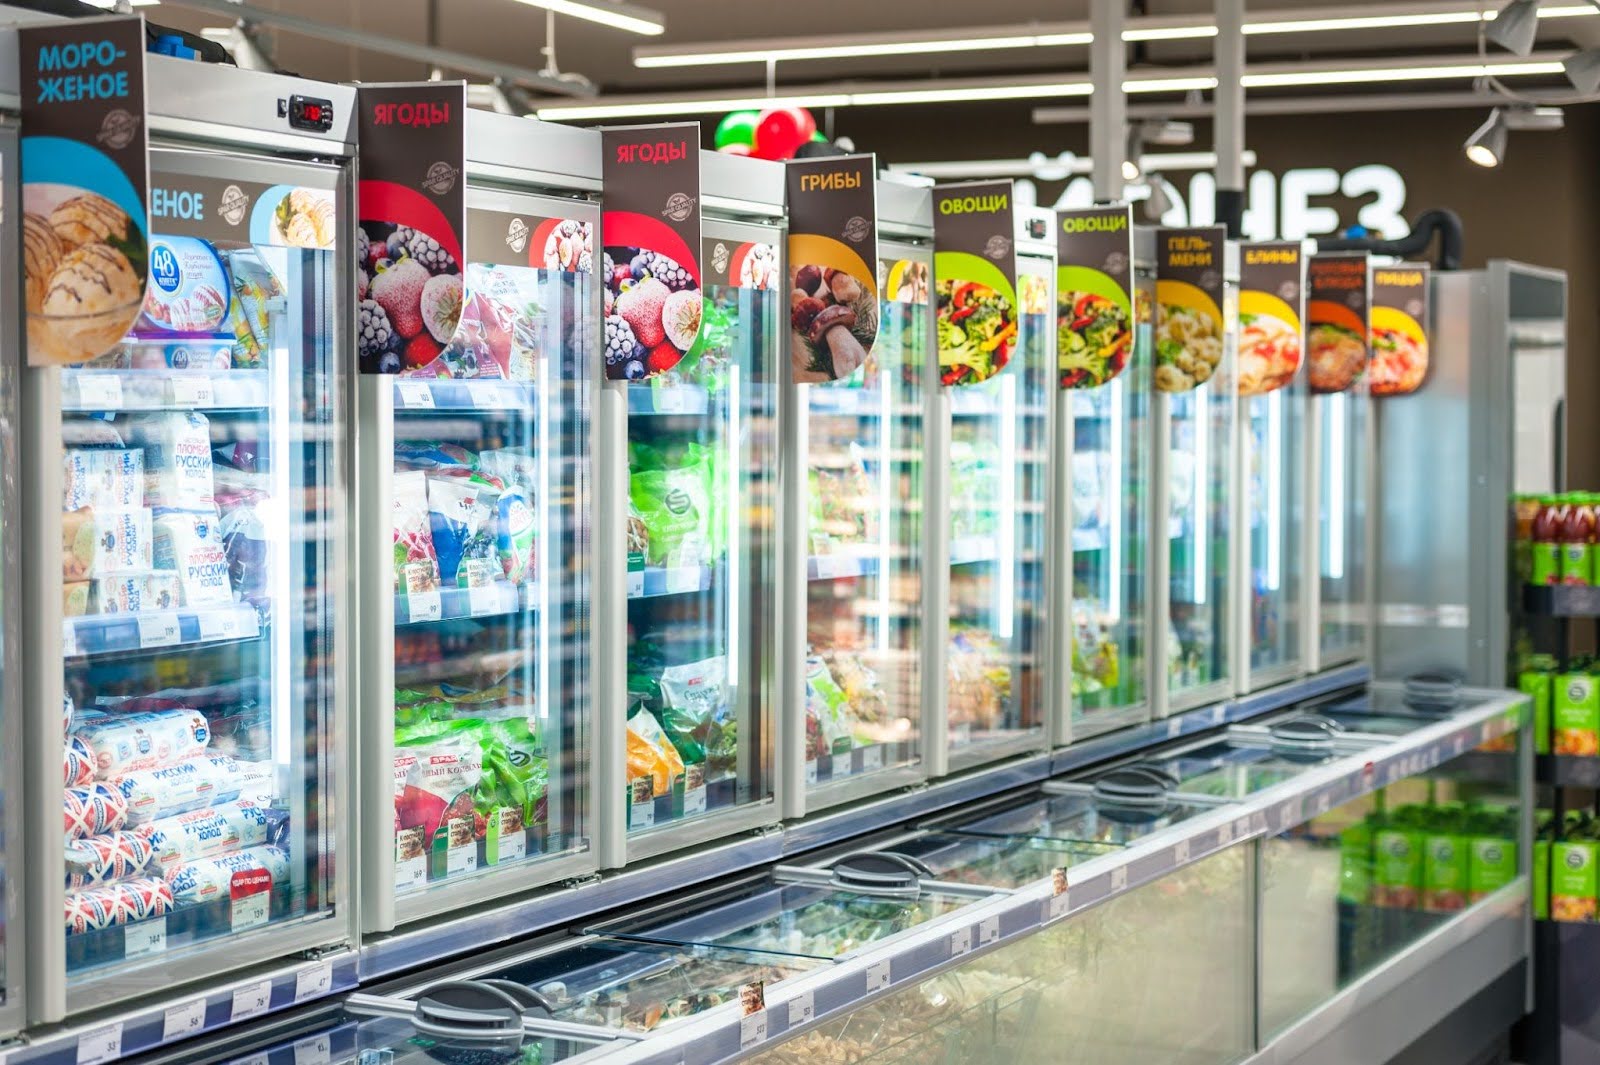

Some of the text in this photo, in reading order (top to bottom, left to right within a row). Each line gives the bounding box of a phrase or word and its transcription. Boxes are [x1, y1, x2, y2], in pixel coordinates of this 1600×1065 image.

[38, 40, 127, 71] МОРО-
[37, 71, 129, 104] ЖЕНОЕ
[374, 102, 449, 128] ЯГОДЫ
[617, 141, 687, 165] ЯГОДЫ
[800, 171, 861, 192] ГРИБЫ
[150, 188, 203, 221] ЕНОЕ
[939, 194, 1008, 215] ОВОЩИ
[1062, 214, 1127, 233] ОВОЩИ
[1168, 236, 1213, 251] ПЕЛЬ-
[153, 249, 175, 277] 48
[1168, 251, 1213, 267] МЕНИ
[1245, 249, 1298, 265] БЛИНЫ
[432, 755, 458, 765] SPAR
[182, 814, 228, 834] РУССКИЙ
[196, 827, 222, 842] ХОЛОД
[253, 908, 264, 920] 139
[148, 934, 160, 945] 144
[256, 997, 265, 1007] 76
[189, 1017, 199, 1027] 56
[106, 1042, 116, 1052] 33
